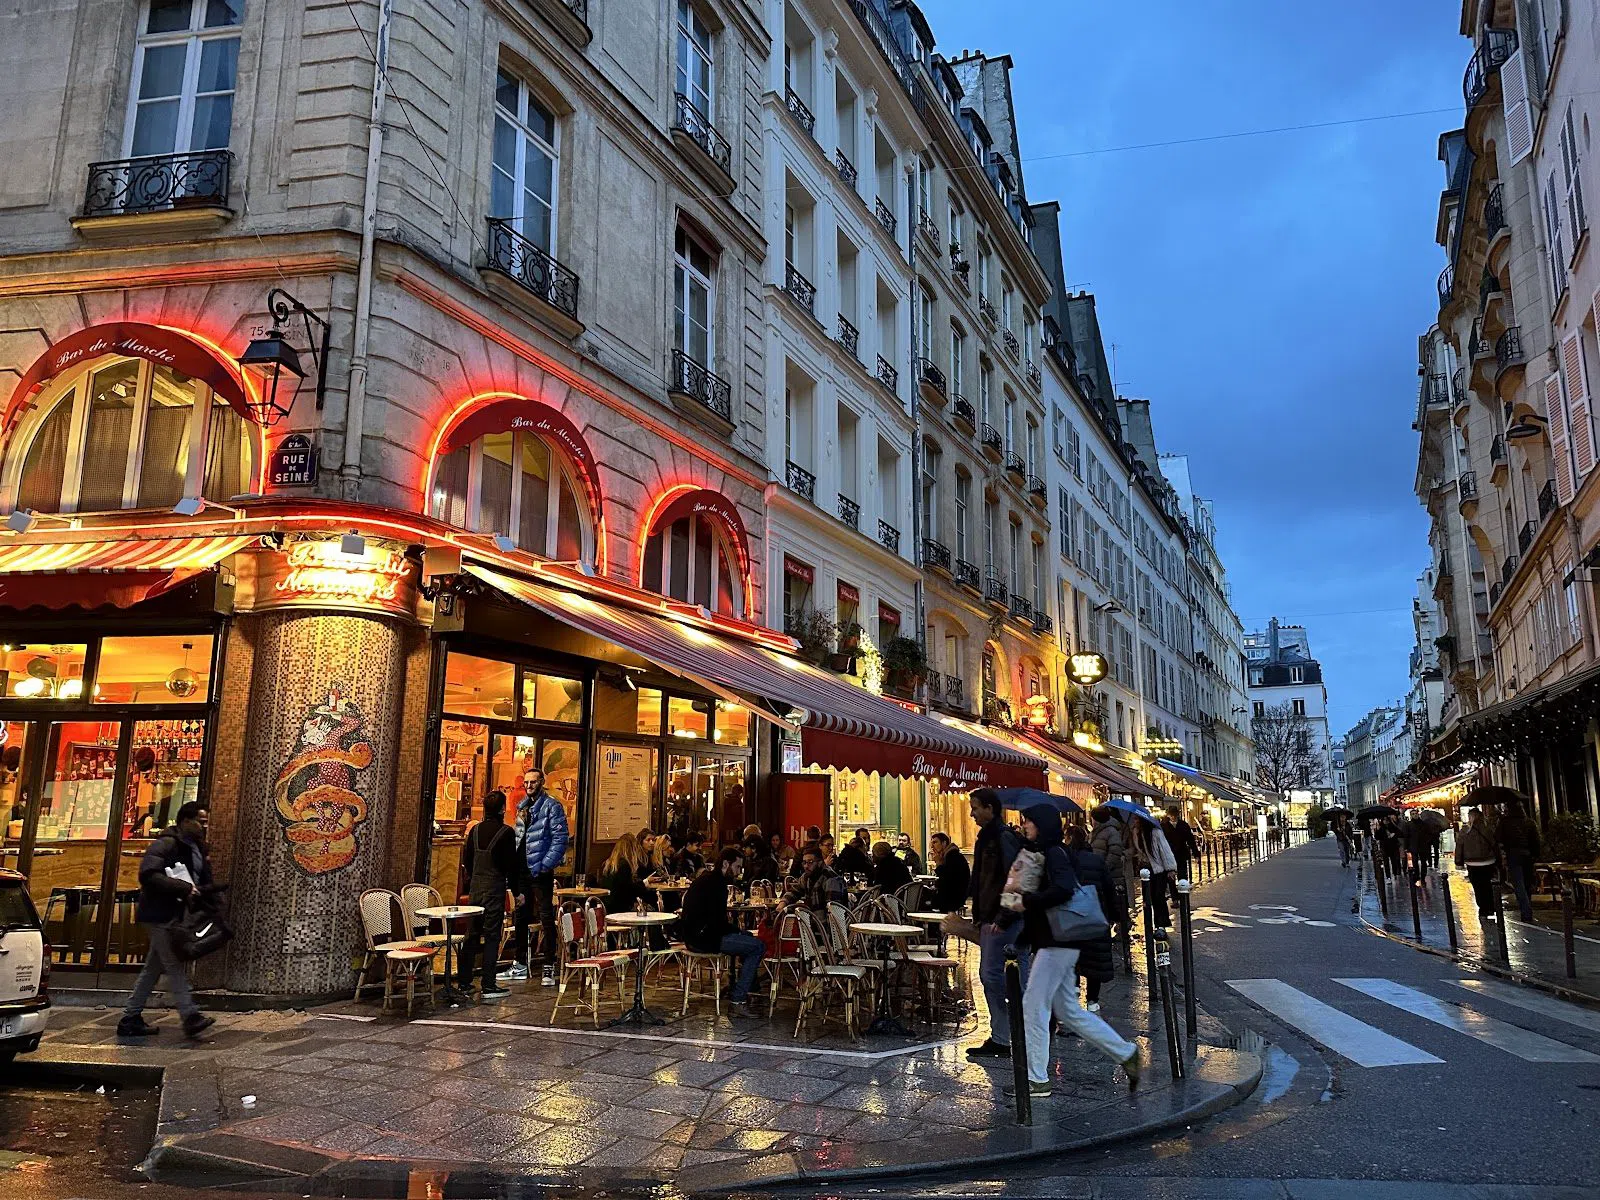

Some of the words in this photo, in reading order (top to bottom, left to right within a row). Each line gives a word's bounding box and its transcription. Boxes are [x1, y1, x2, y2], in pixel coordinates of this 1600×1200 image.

[250, 326, 264, 337] 75
[56, 349, 83, 368] Bar
[89, 338, 107, 352] du
[112, 338, 175, 363] Marché
[511, 416, 534, 428] Bar
[537, 419, 551, 430] du
[553, 428, 585, 459] Marché
[282, 454, 305, 465] RUE
[274, 472, 309, 483] SEINE
[693, 502, 707, 512] Bar
[709, 504, 718, 513] du
[912, 753, 936, 774] Bar
[939, 760, 954, 777] du
[955, 762, 988, 782] Marché
